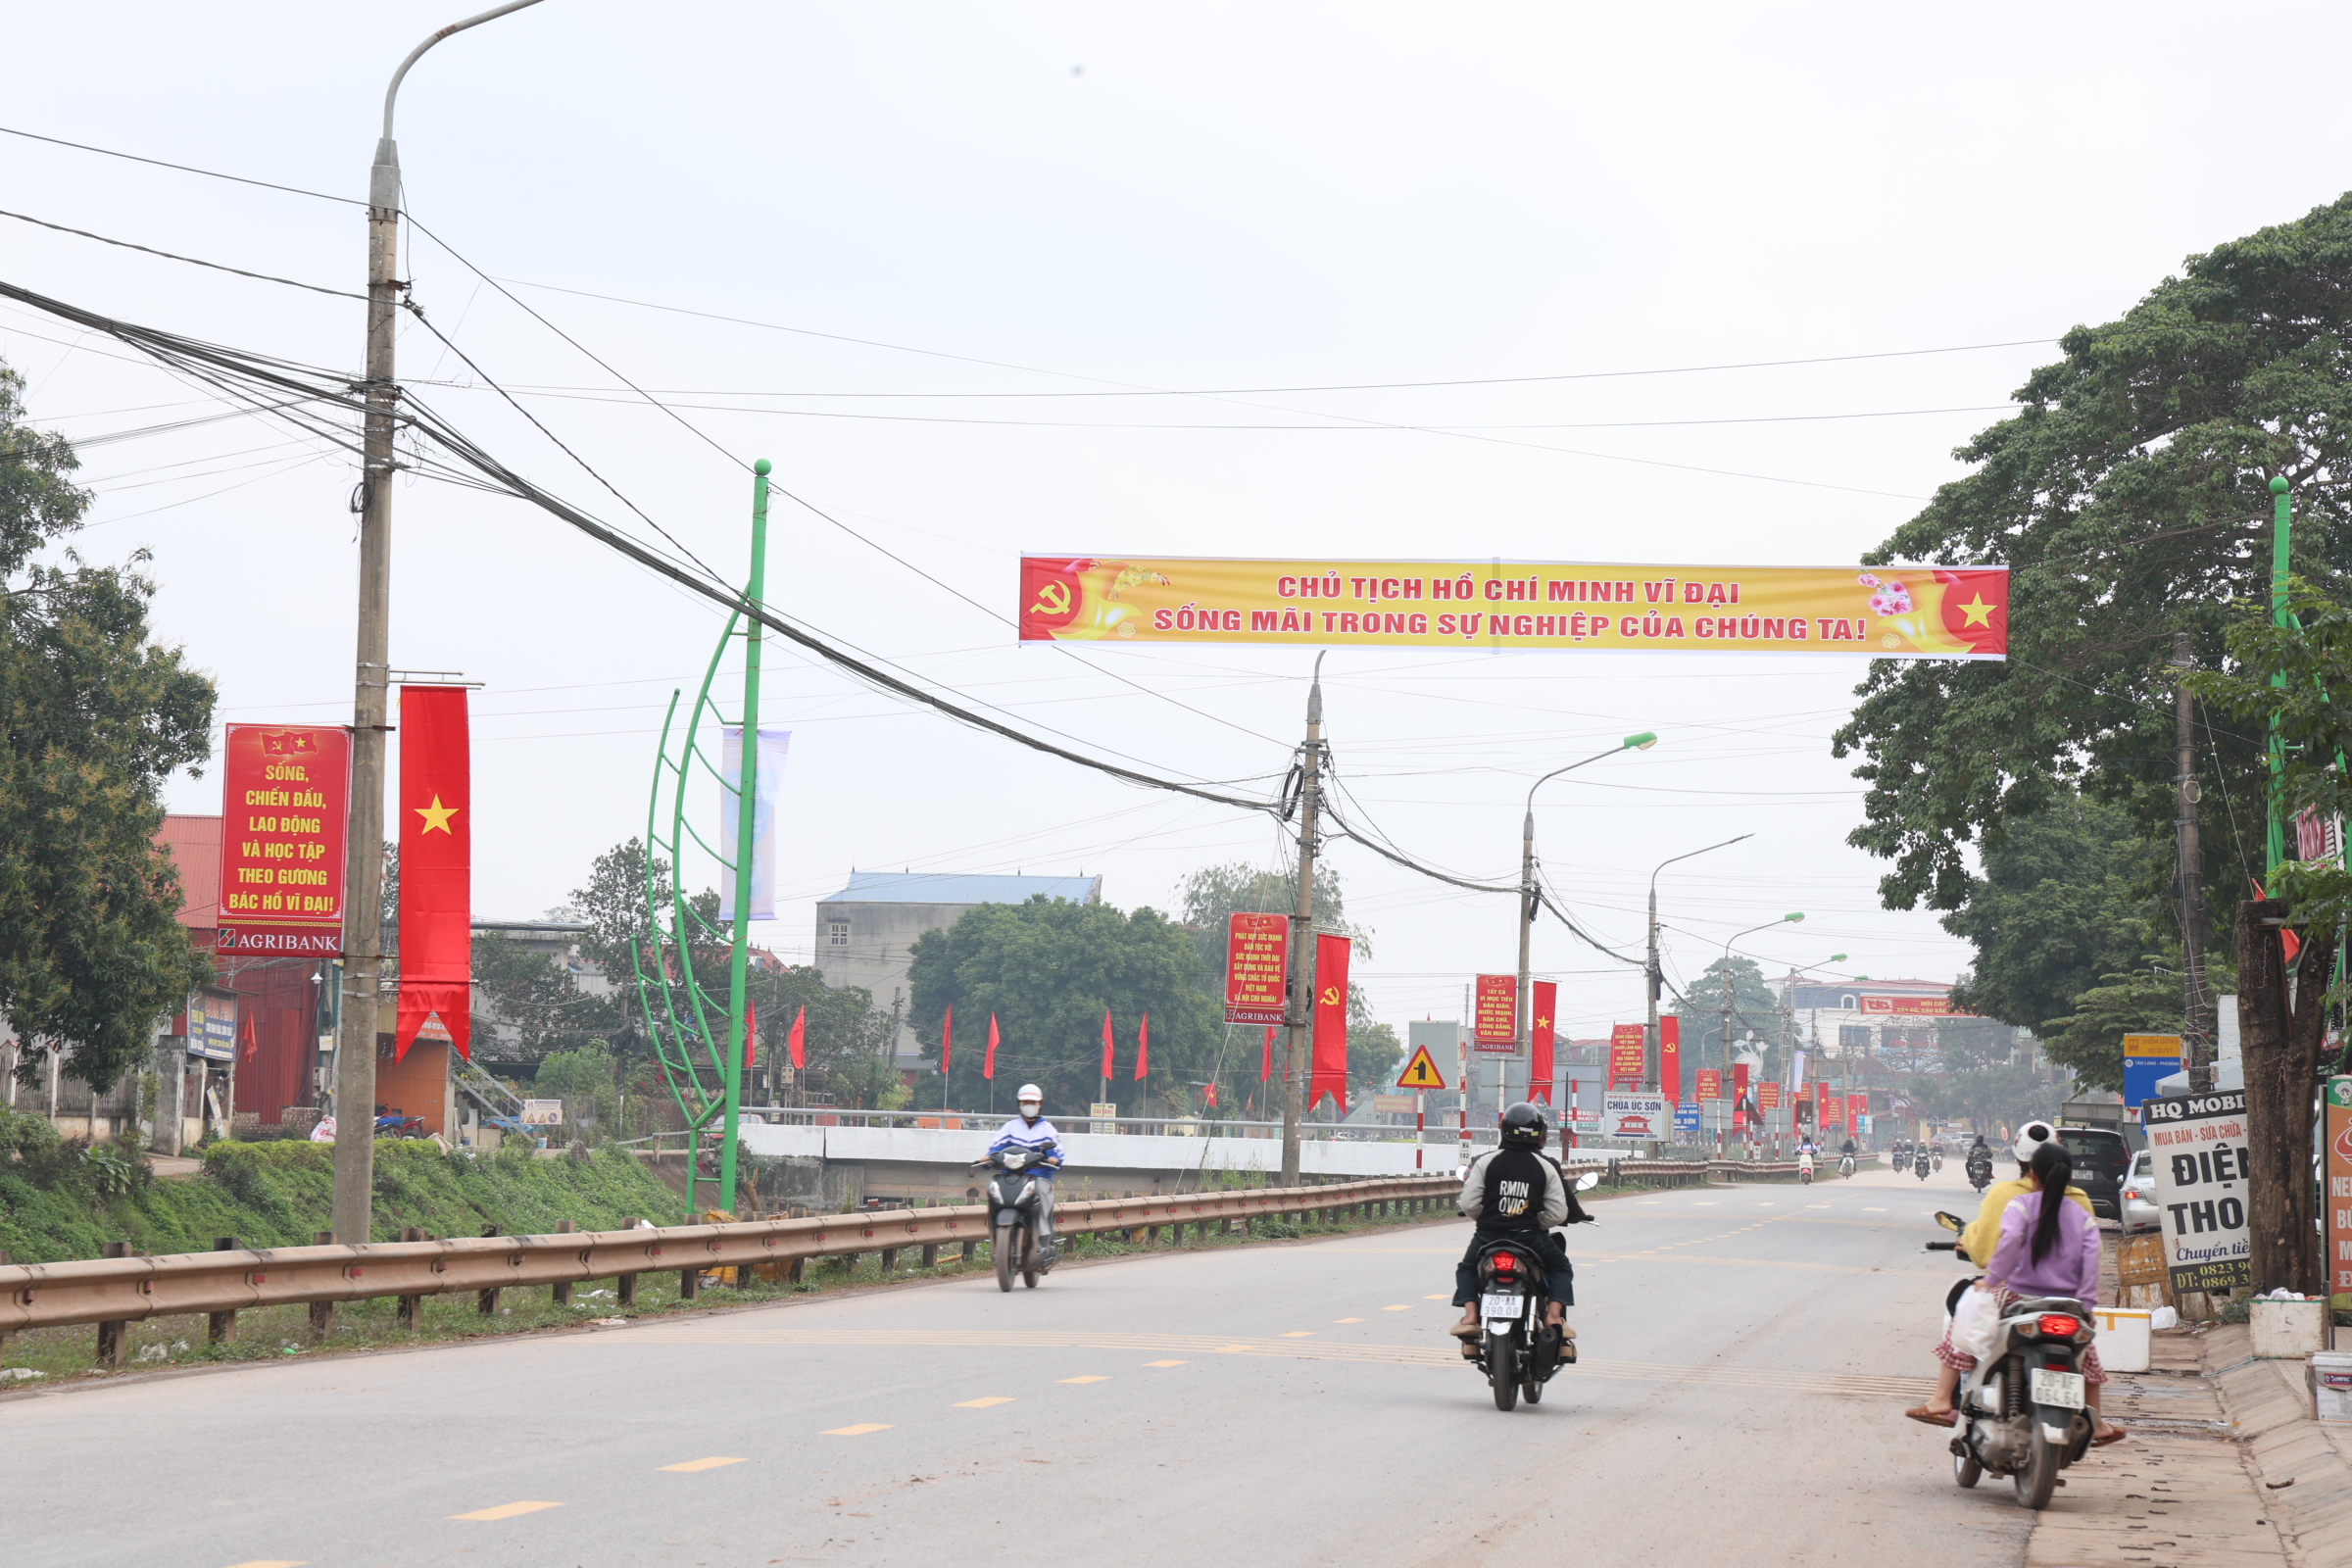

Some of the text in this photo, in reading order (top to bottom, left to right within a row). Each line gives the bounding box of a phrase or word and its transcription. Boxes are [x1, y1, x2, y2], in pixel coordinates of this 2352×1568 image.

[1277, 570, 1740, 609] CHỦ TỊCH HỒ CHÍ MINH VĨ ĐẠI
[1153, 602, 1867, 642] SỐNG MÃI TRONG SỰ NGHIỆP CỦA CHÚNG TA!
[265, 760, 309, 783] SỐNG,
[245, 786, 327, 809] CHIẾN ĐẤU,
[249, 814, 320, 836] LAO ĐỘNG
[242, 840, 325, 862] VÀ HỌC TẬP
[238, 867, 327, 886] THEO GƯƠNG
[228, 890, 334, 914] BÁC HỒ VĨ ĐẠI!
[238, 933, 338, 951] AGRIBANK
[1235, 1012, 1282, 1022] AGRIBANK
[1608, 1100, 1661, 1111] CHÙA ÚC SƠN
[2150, 1095, 2246, 1119] HQ MOBI
[2154, 1121, 2242, 1146] MUA BÁN SỬA CHỮA
[1499, 1180, 1529, 1198] RMIN
[2167, 1197, 2250, 1235] THO
[2176, 1238, 2250, 1262] Chuyển tiề
[2177, 1272, 2198, 1288] ĐT:
[2200, 1263, 2233, 1276] 0823
[2202, 1274, 2250, 1288] 0869 3
[1484, 1306, 1519, 1316] 390.08
[1488, 1296, 1516, 1306] 20-AA
